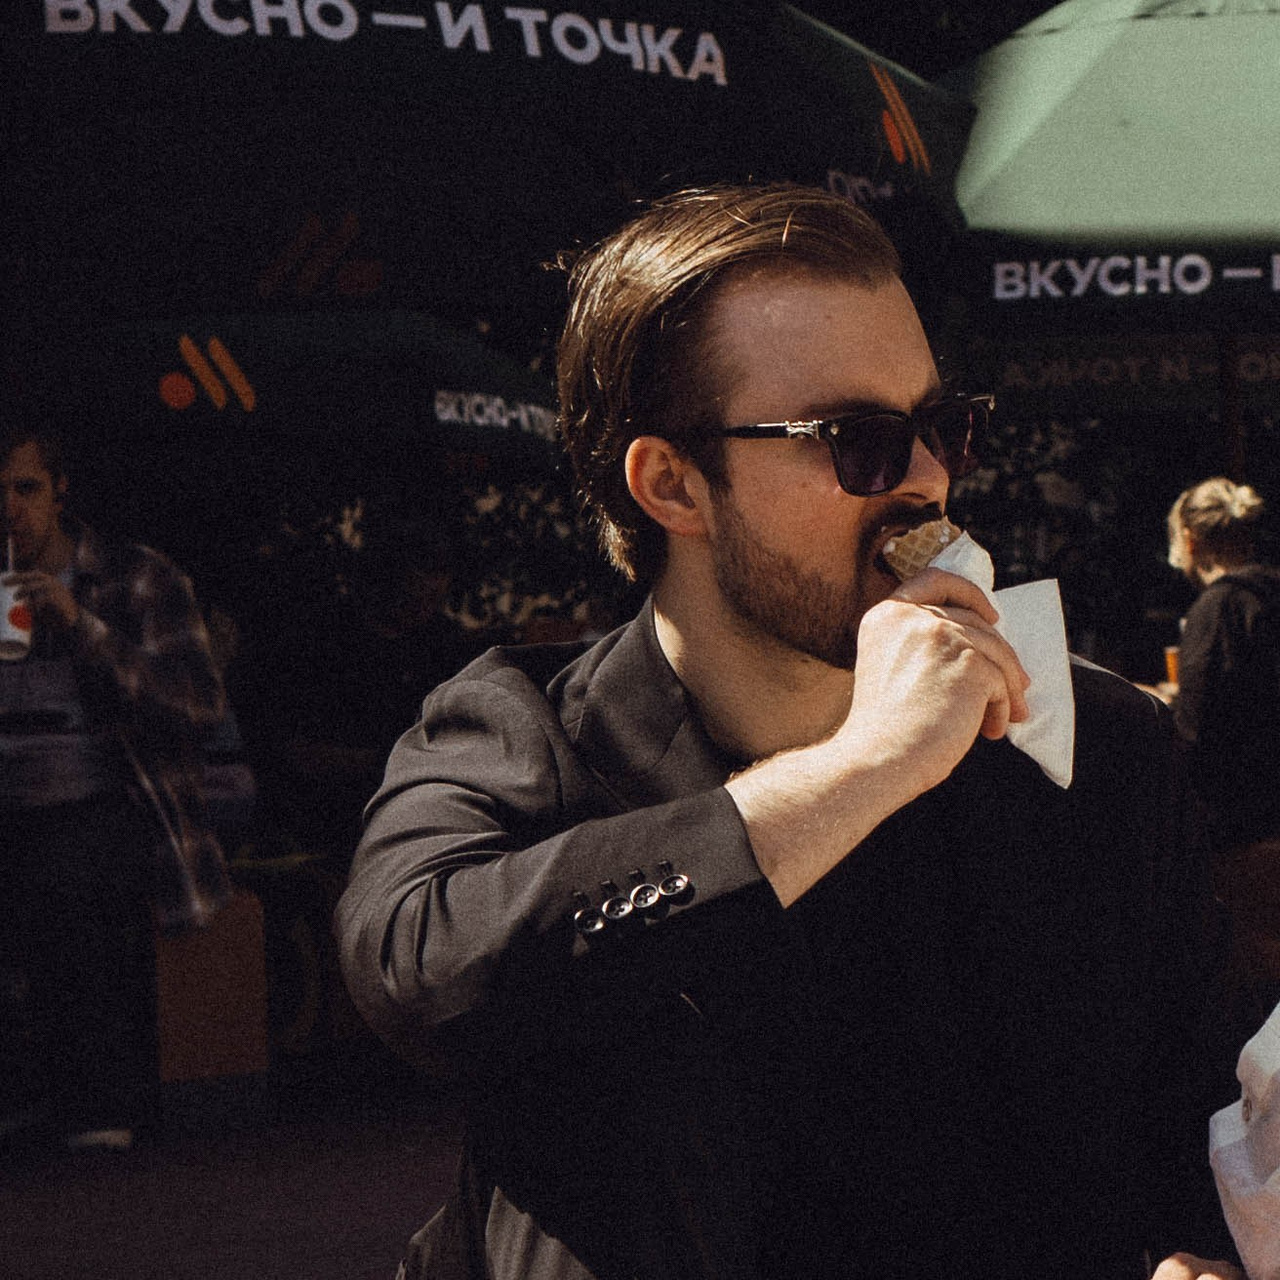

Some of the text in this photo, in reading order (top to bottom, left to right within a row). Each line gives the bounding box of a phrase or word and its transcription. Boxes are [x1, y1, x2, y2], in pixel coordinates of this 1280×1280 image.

[435, 1, 491, 52] И
[504, 6, 728, 86] ТОЧКА
[993, 253, 1212, 299] ВКУСНО
